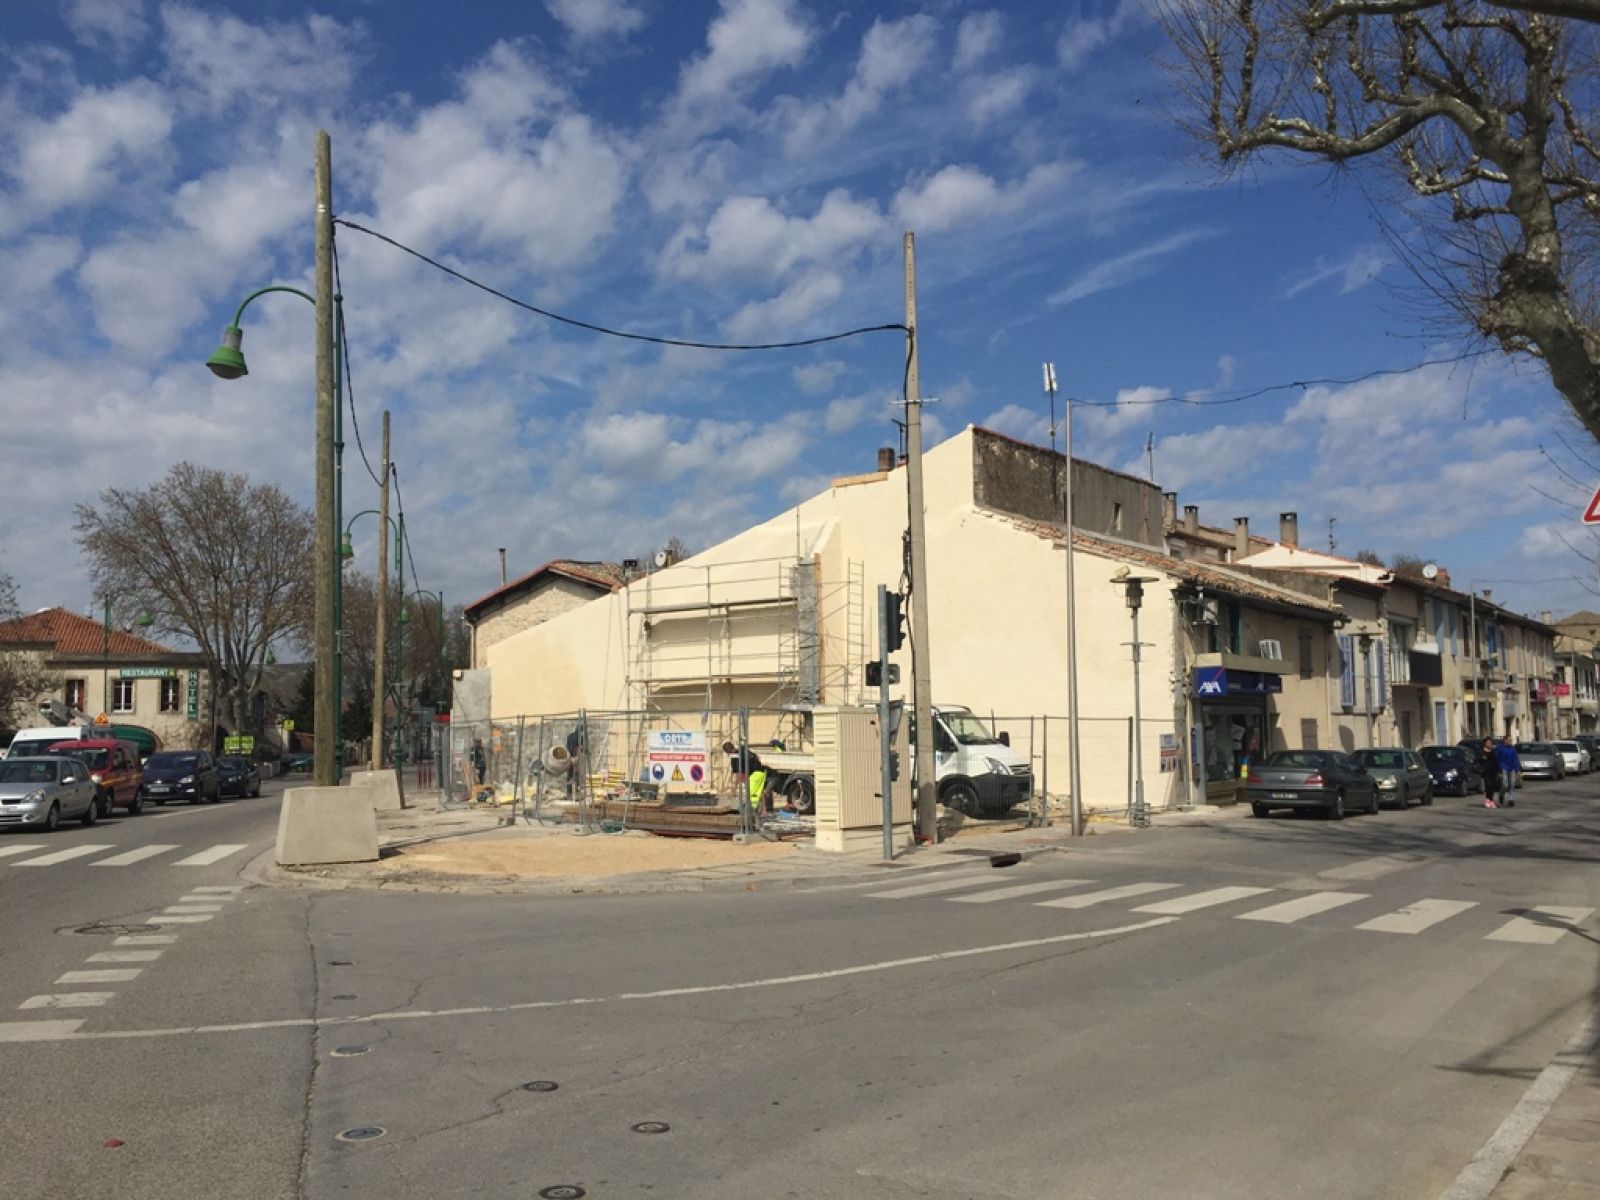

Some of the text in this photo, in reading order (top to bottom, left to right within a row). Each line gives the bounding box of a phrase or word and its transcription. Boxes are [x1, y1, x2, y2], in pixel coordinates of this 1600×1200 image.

[122, 668, 168, 676] RESTAURANT
[189, 671, 197, 712] HOTEL
[1198, 681, 1222, 693] AXA
